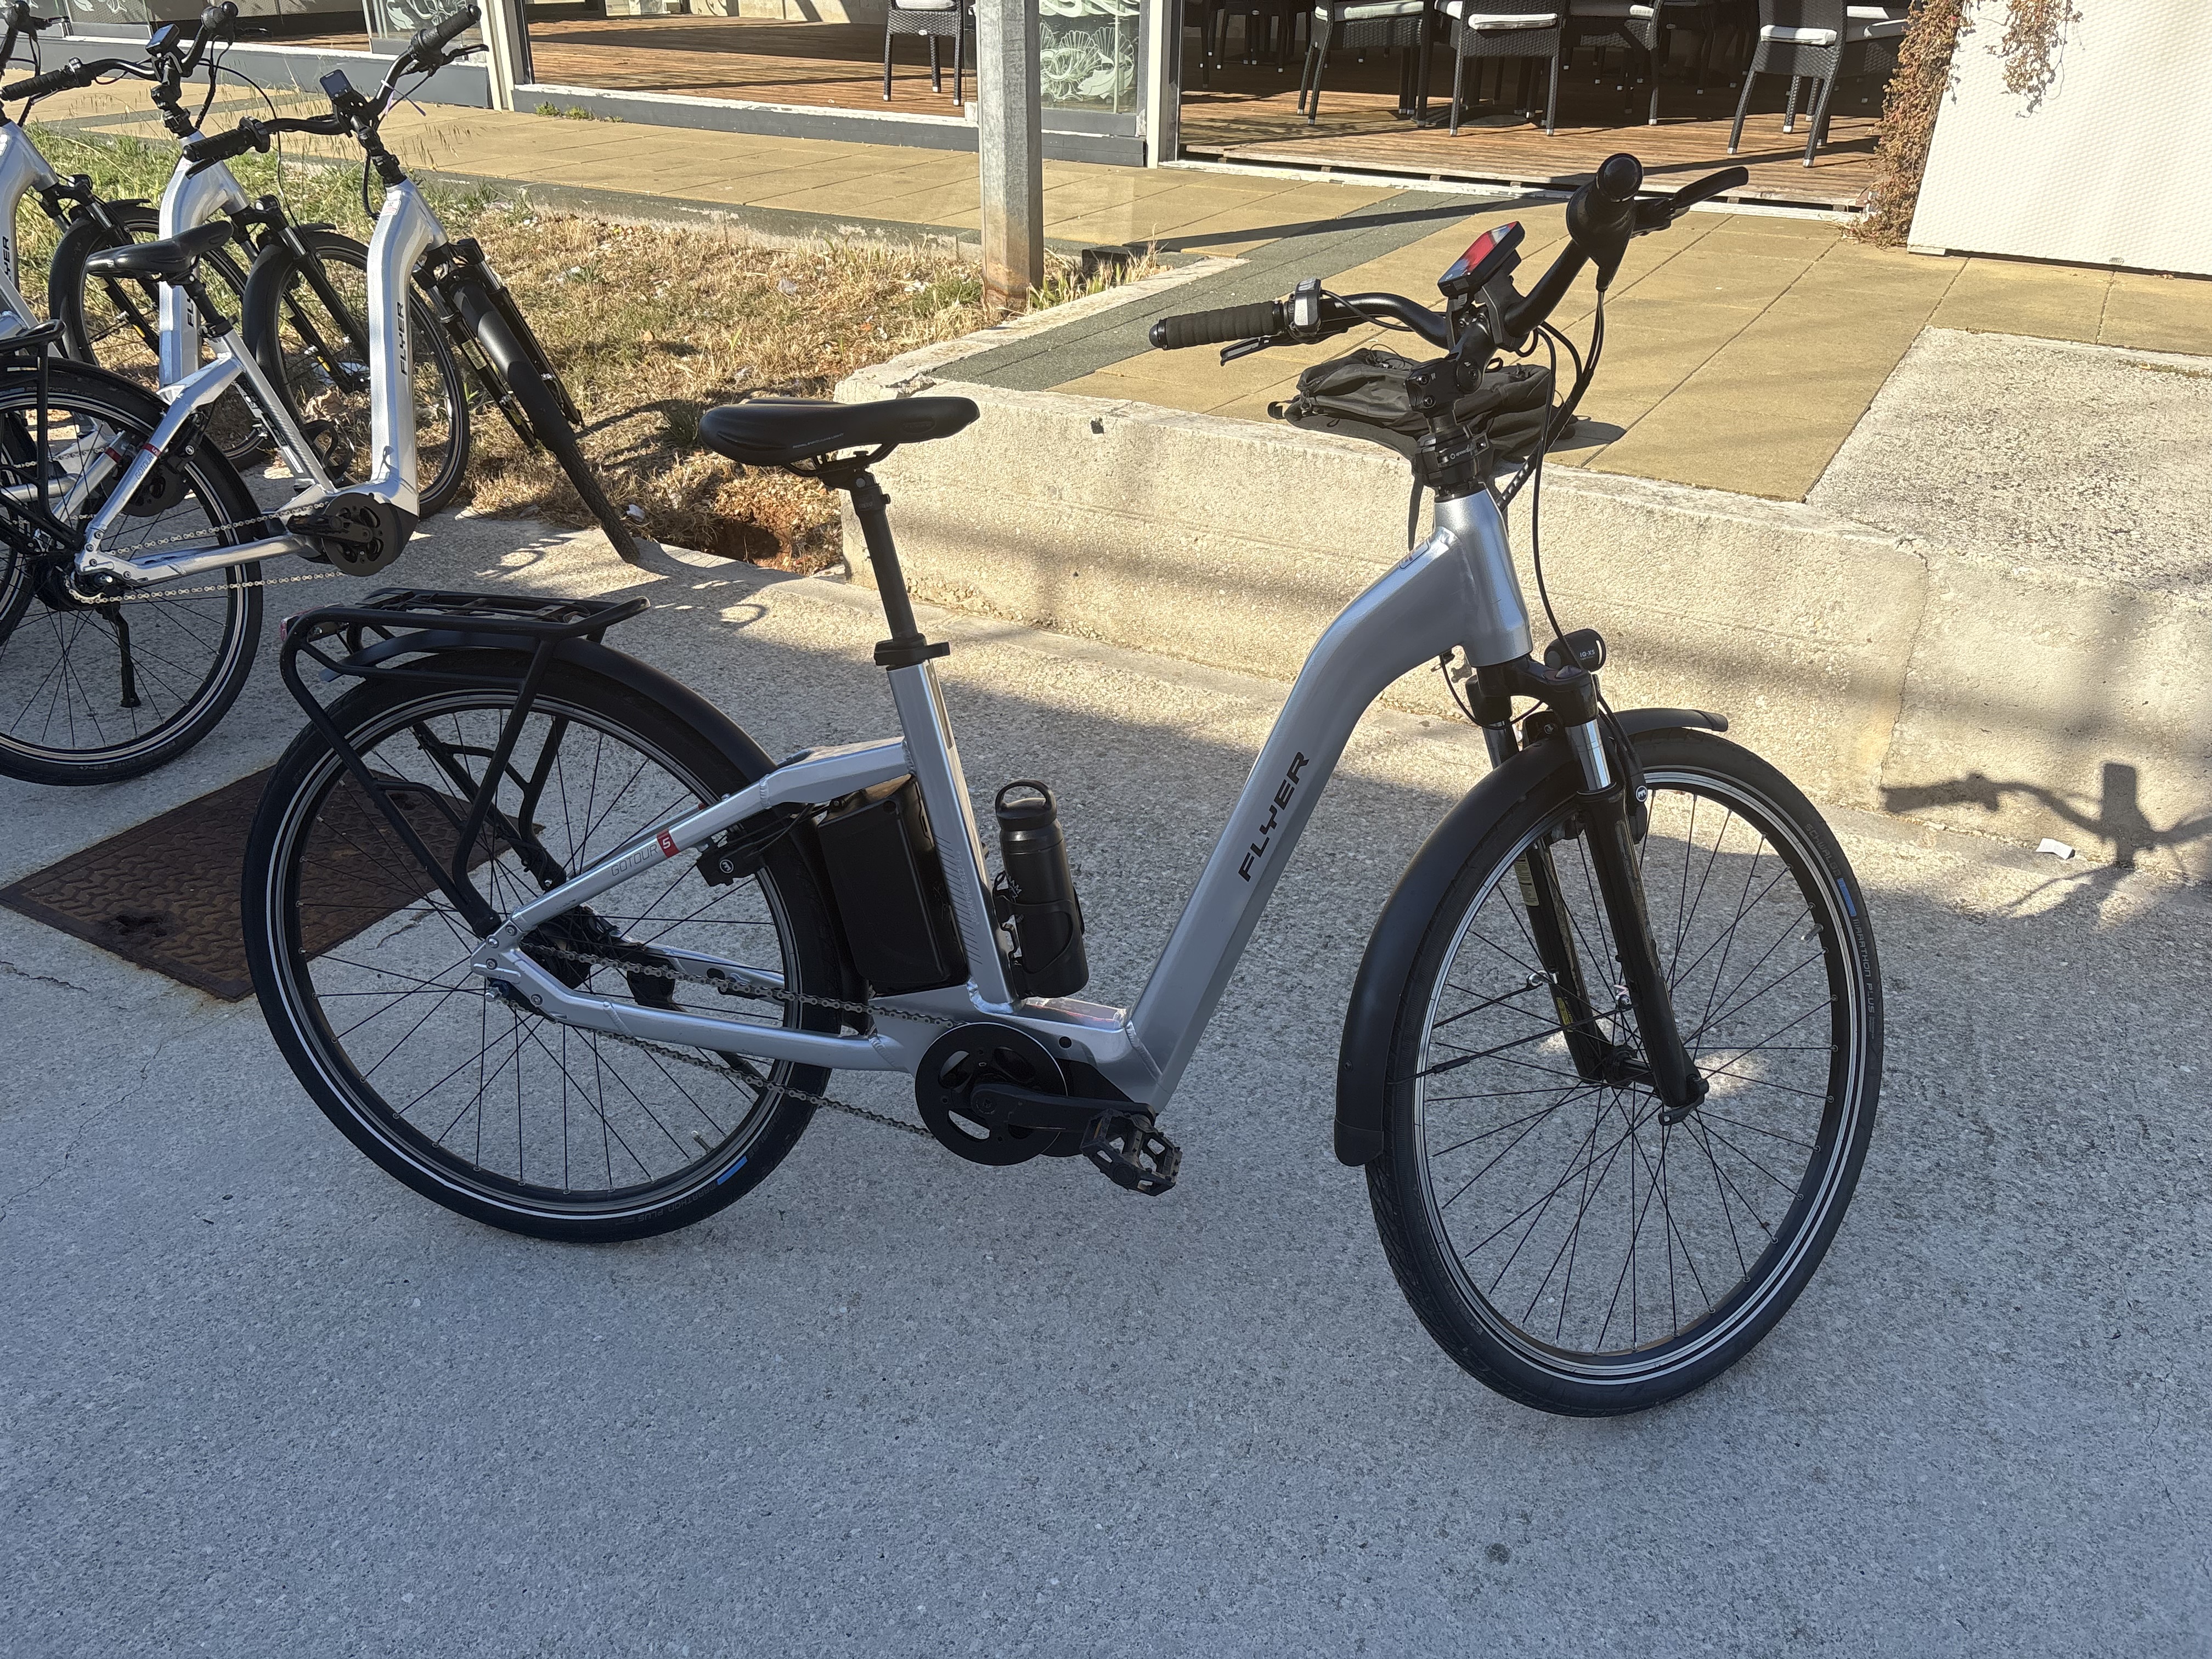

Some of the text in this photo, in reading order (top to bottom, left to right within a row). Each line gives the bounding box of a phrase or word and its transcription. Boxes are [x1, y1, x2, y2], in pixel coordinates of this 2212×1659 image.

[3, 236, 11, 280] YER
[397, 301, 407, 376] FLYER
[135, 453, 154, 480] GOTOUR
[1579, 649, 1595, 658] IQ-XS
[1238, 752, 1310, 882] FLYER
[611, 837, 671, 876] GOTOUR 5
[1852, 918, 1872, 978] MARATHON
[1866, 982, 1875, 1014] PLUS
